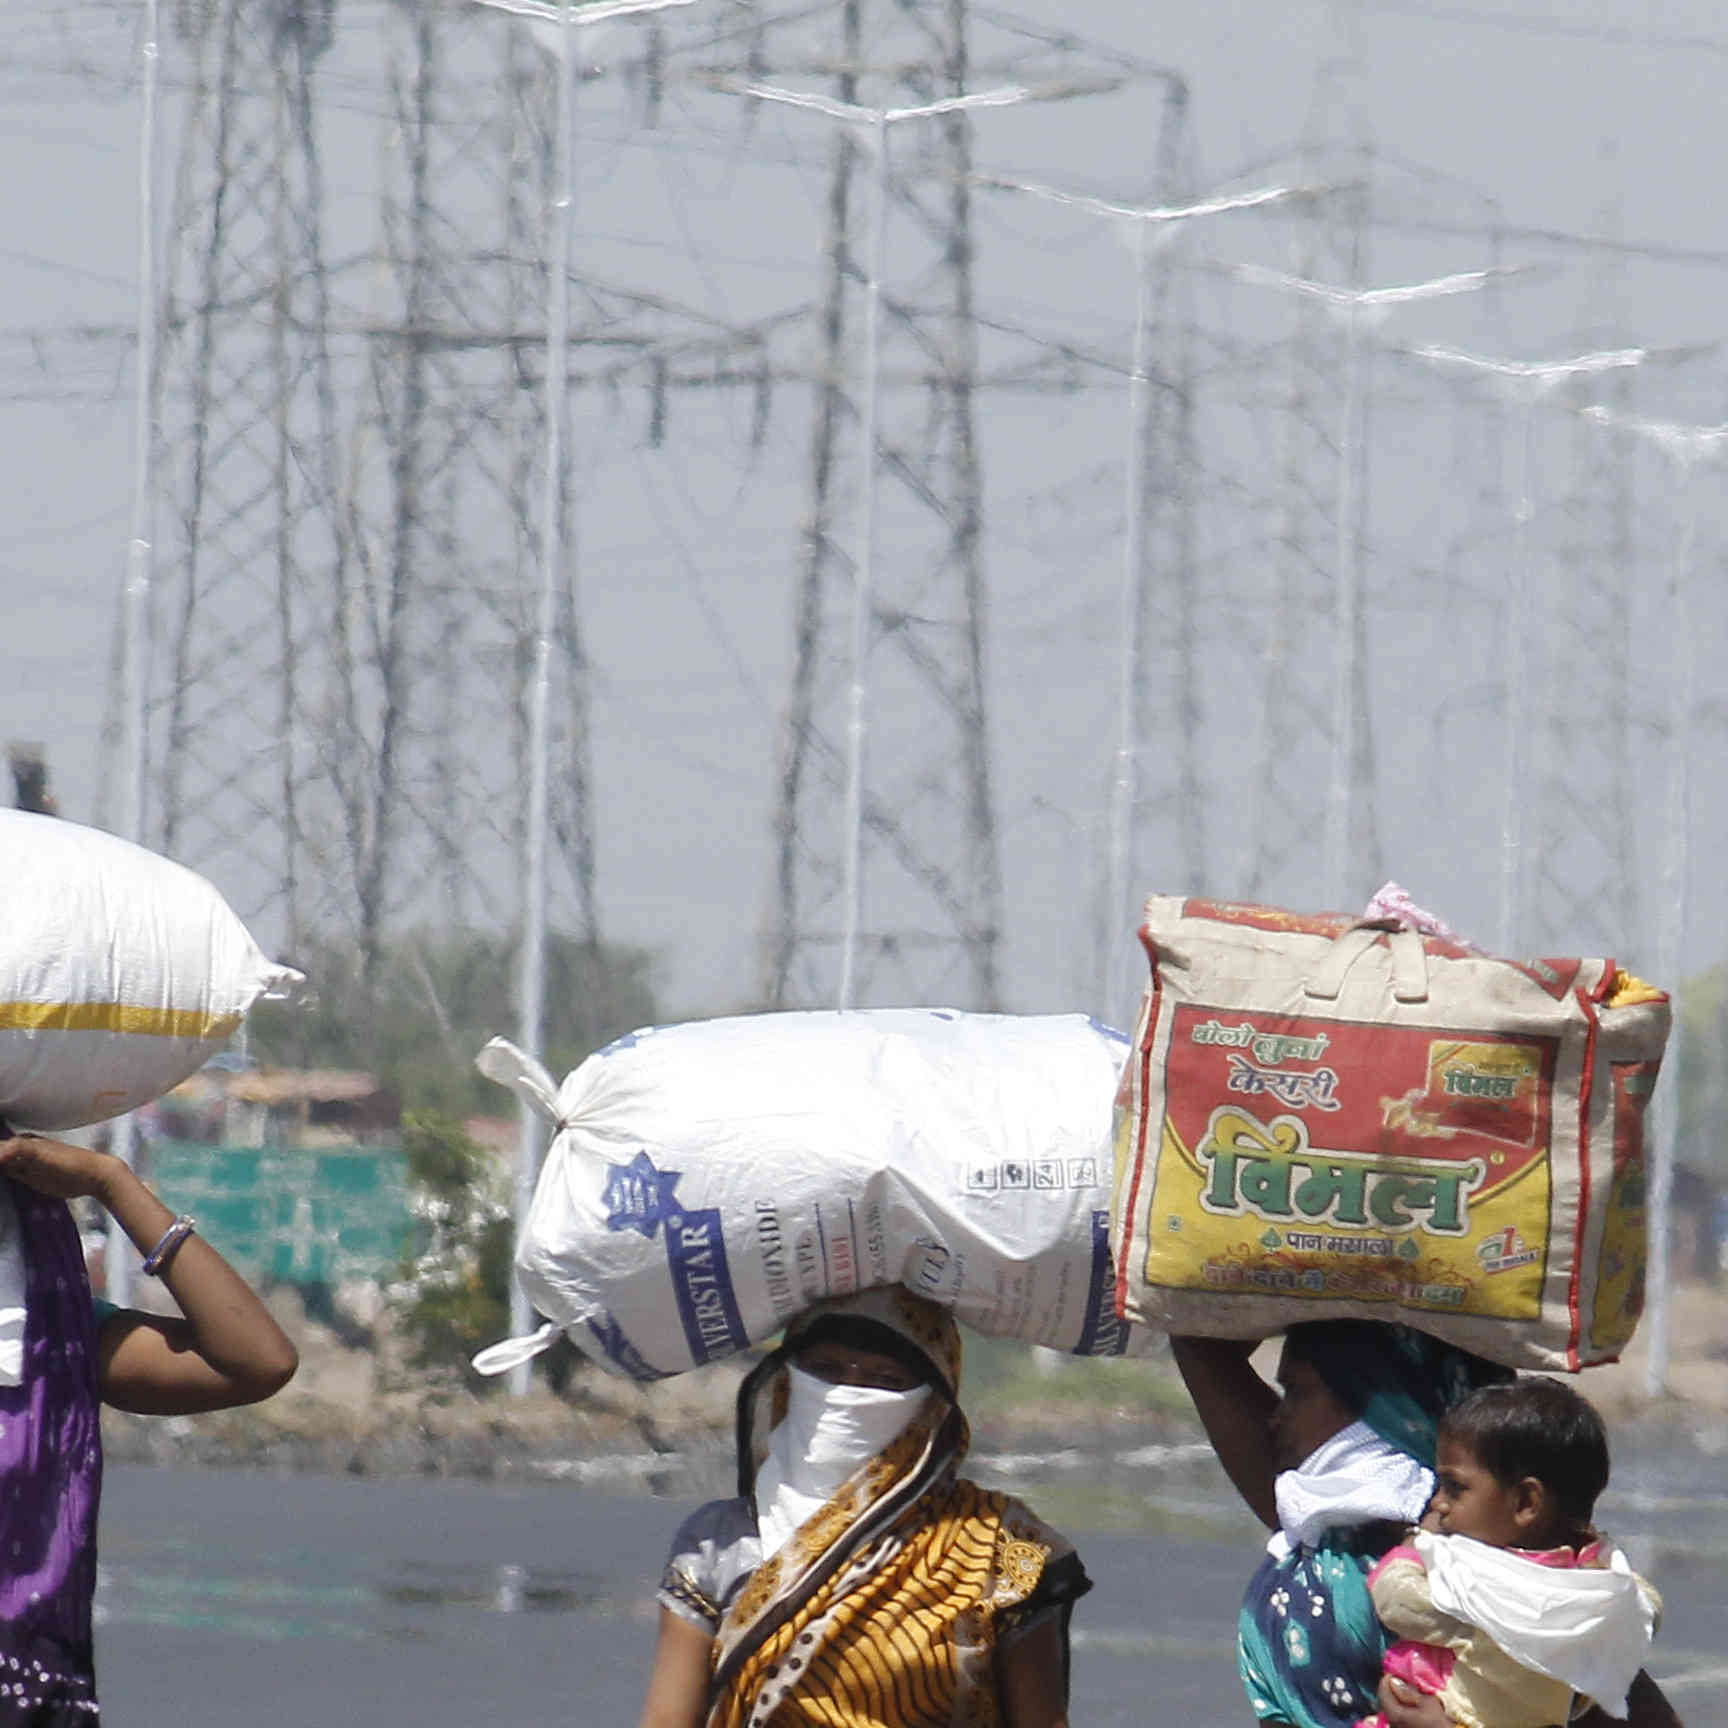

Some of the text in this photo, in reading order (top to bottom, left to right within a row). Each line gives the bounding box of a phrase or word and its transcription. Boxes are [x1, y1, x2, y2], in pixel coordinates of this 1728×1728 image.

[1192, 1020, 1255, 1047] बोलो
[1227, 1053, 1341, 1111] केसरी
[1199, 1108, 1484, 1235] विमल
[1287, 1232, 1322, 1252] पान
